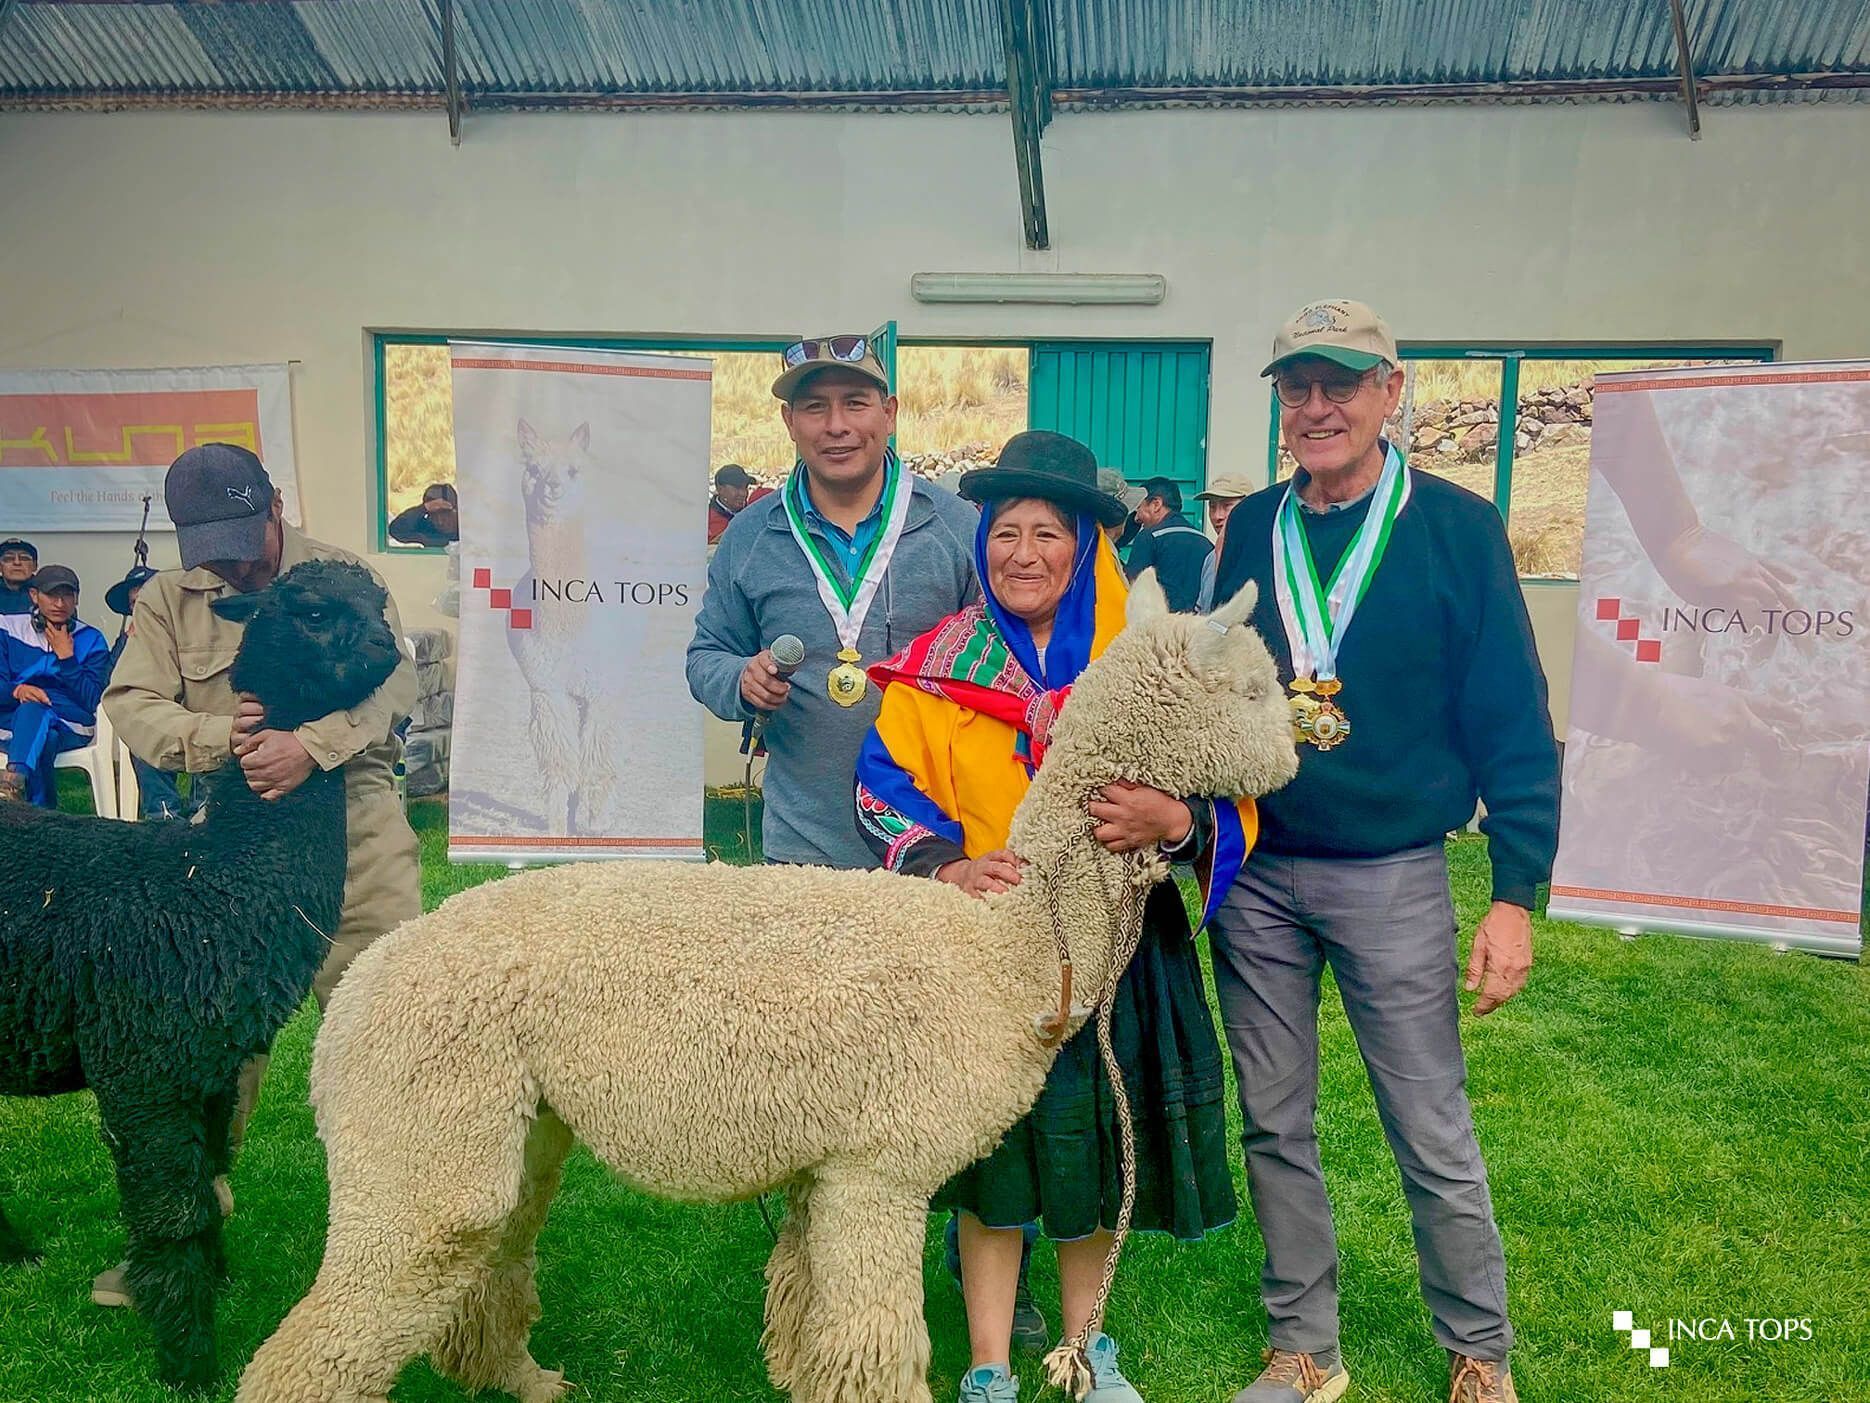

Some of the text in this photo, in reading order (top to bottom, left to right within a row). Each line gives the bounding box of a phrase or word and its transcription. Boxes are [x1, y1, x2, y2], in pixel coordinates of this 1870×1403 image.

[50, 489, 73, 503] Feel
[532, 578, 689, 607] INCA TOPS
[1662, 607, 1854, 637] INCA TOPS
